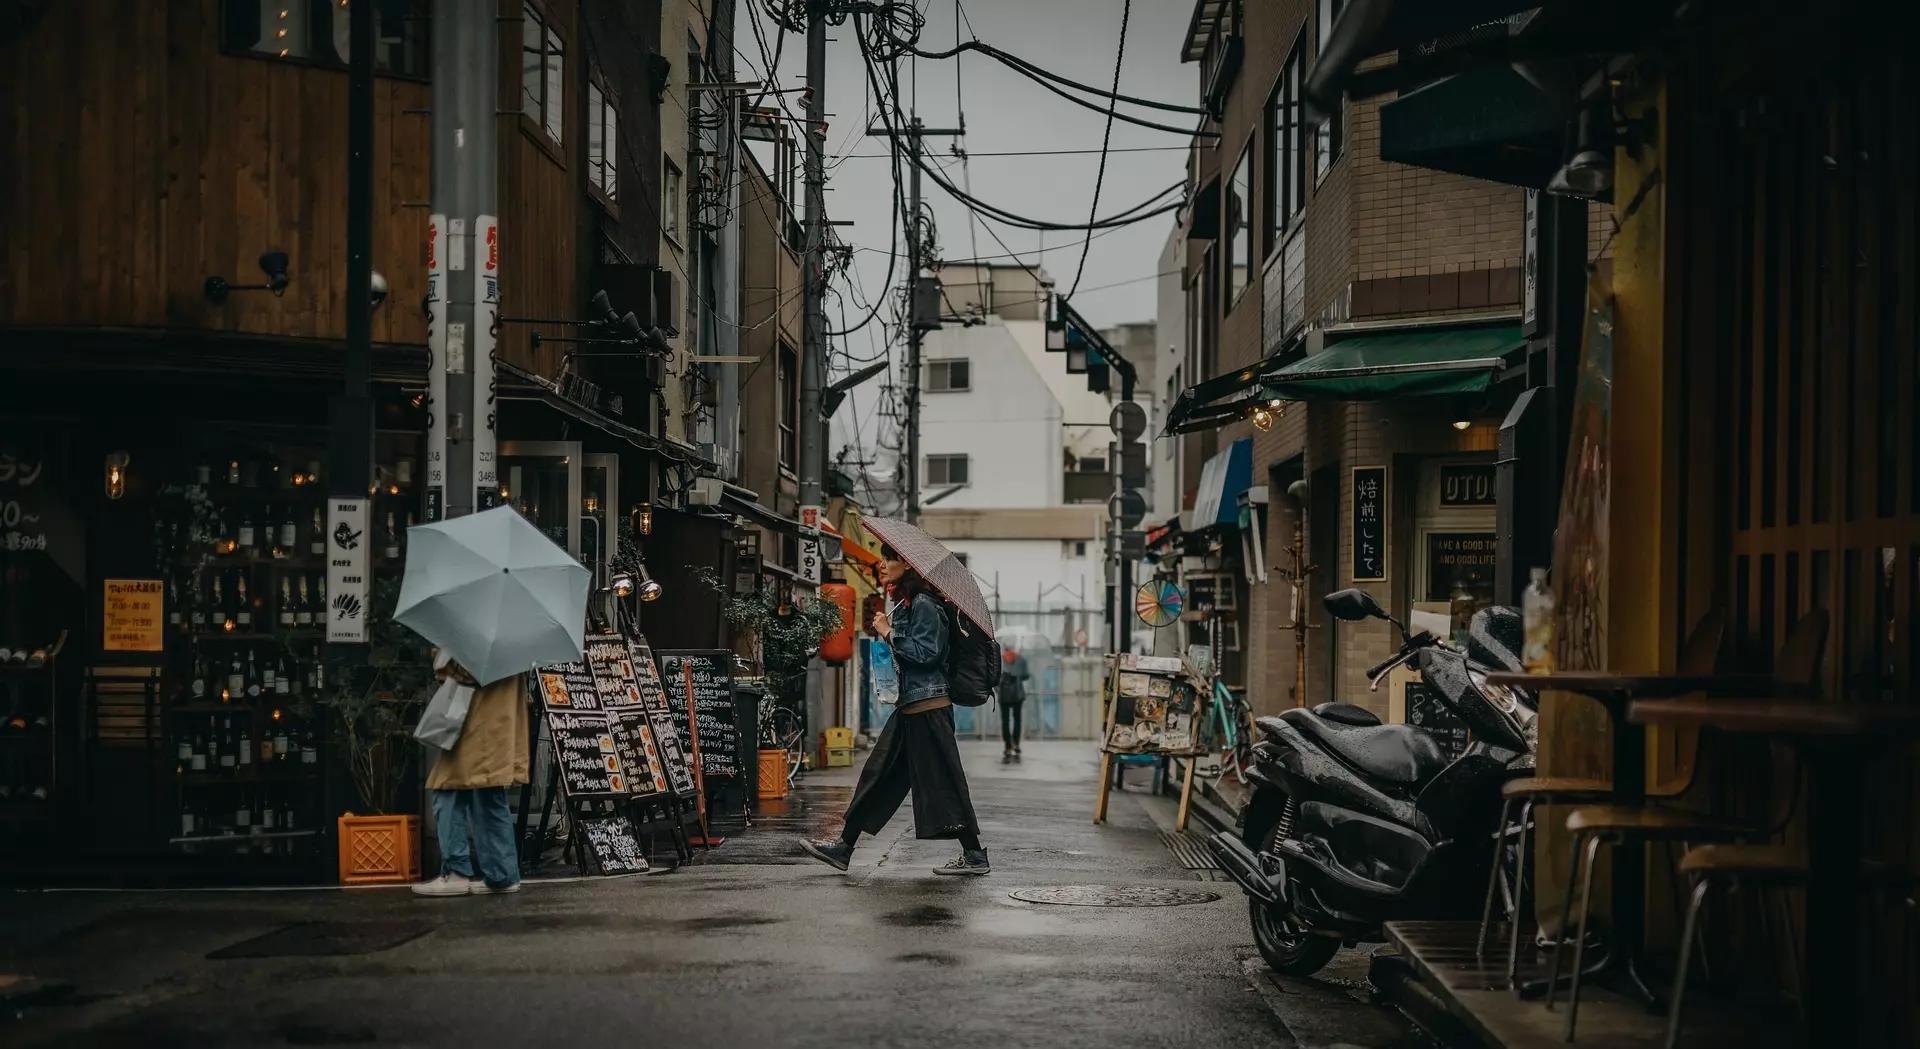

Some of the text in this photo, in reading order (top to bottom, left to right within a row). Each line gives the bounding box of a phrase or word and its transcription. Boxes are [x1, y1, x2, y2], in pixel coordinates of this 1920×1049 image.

[1455, 540, 1461, 550] A
[1462, 540, 1483, 550] GOOD
[1440, 555, 1455, 565] AND
[1457, 555, 1478, 565] GOOD
